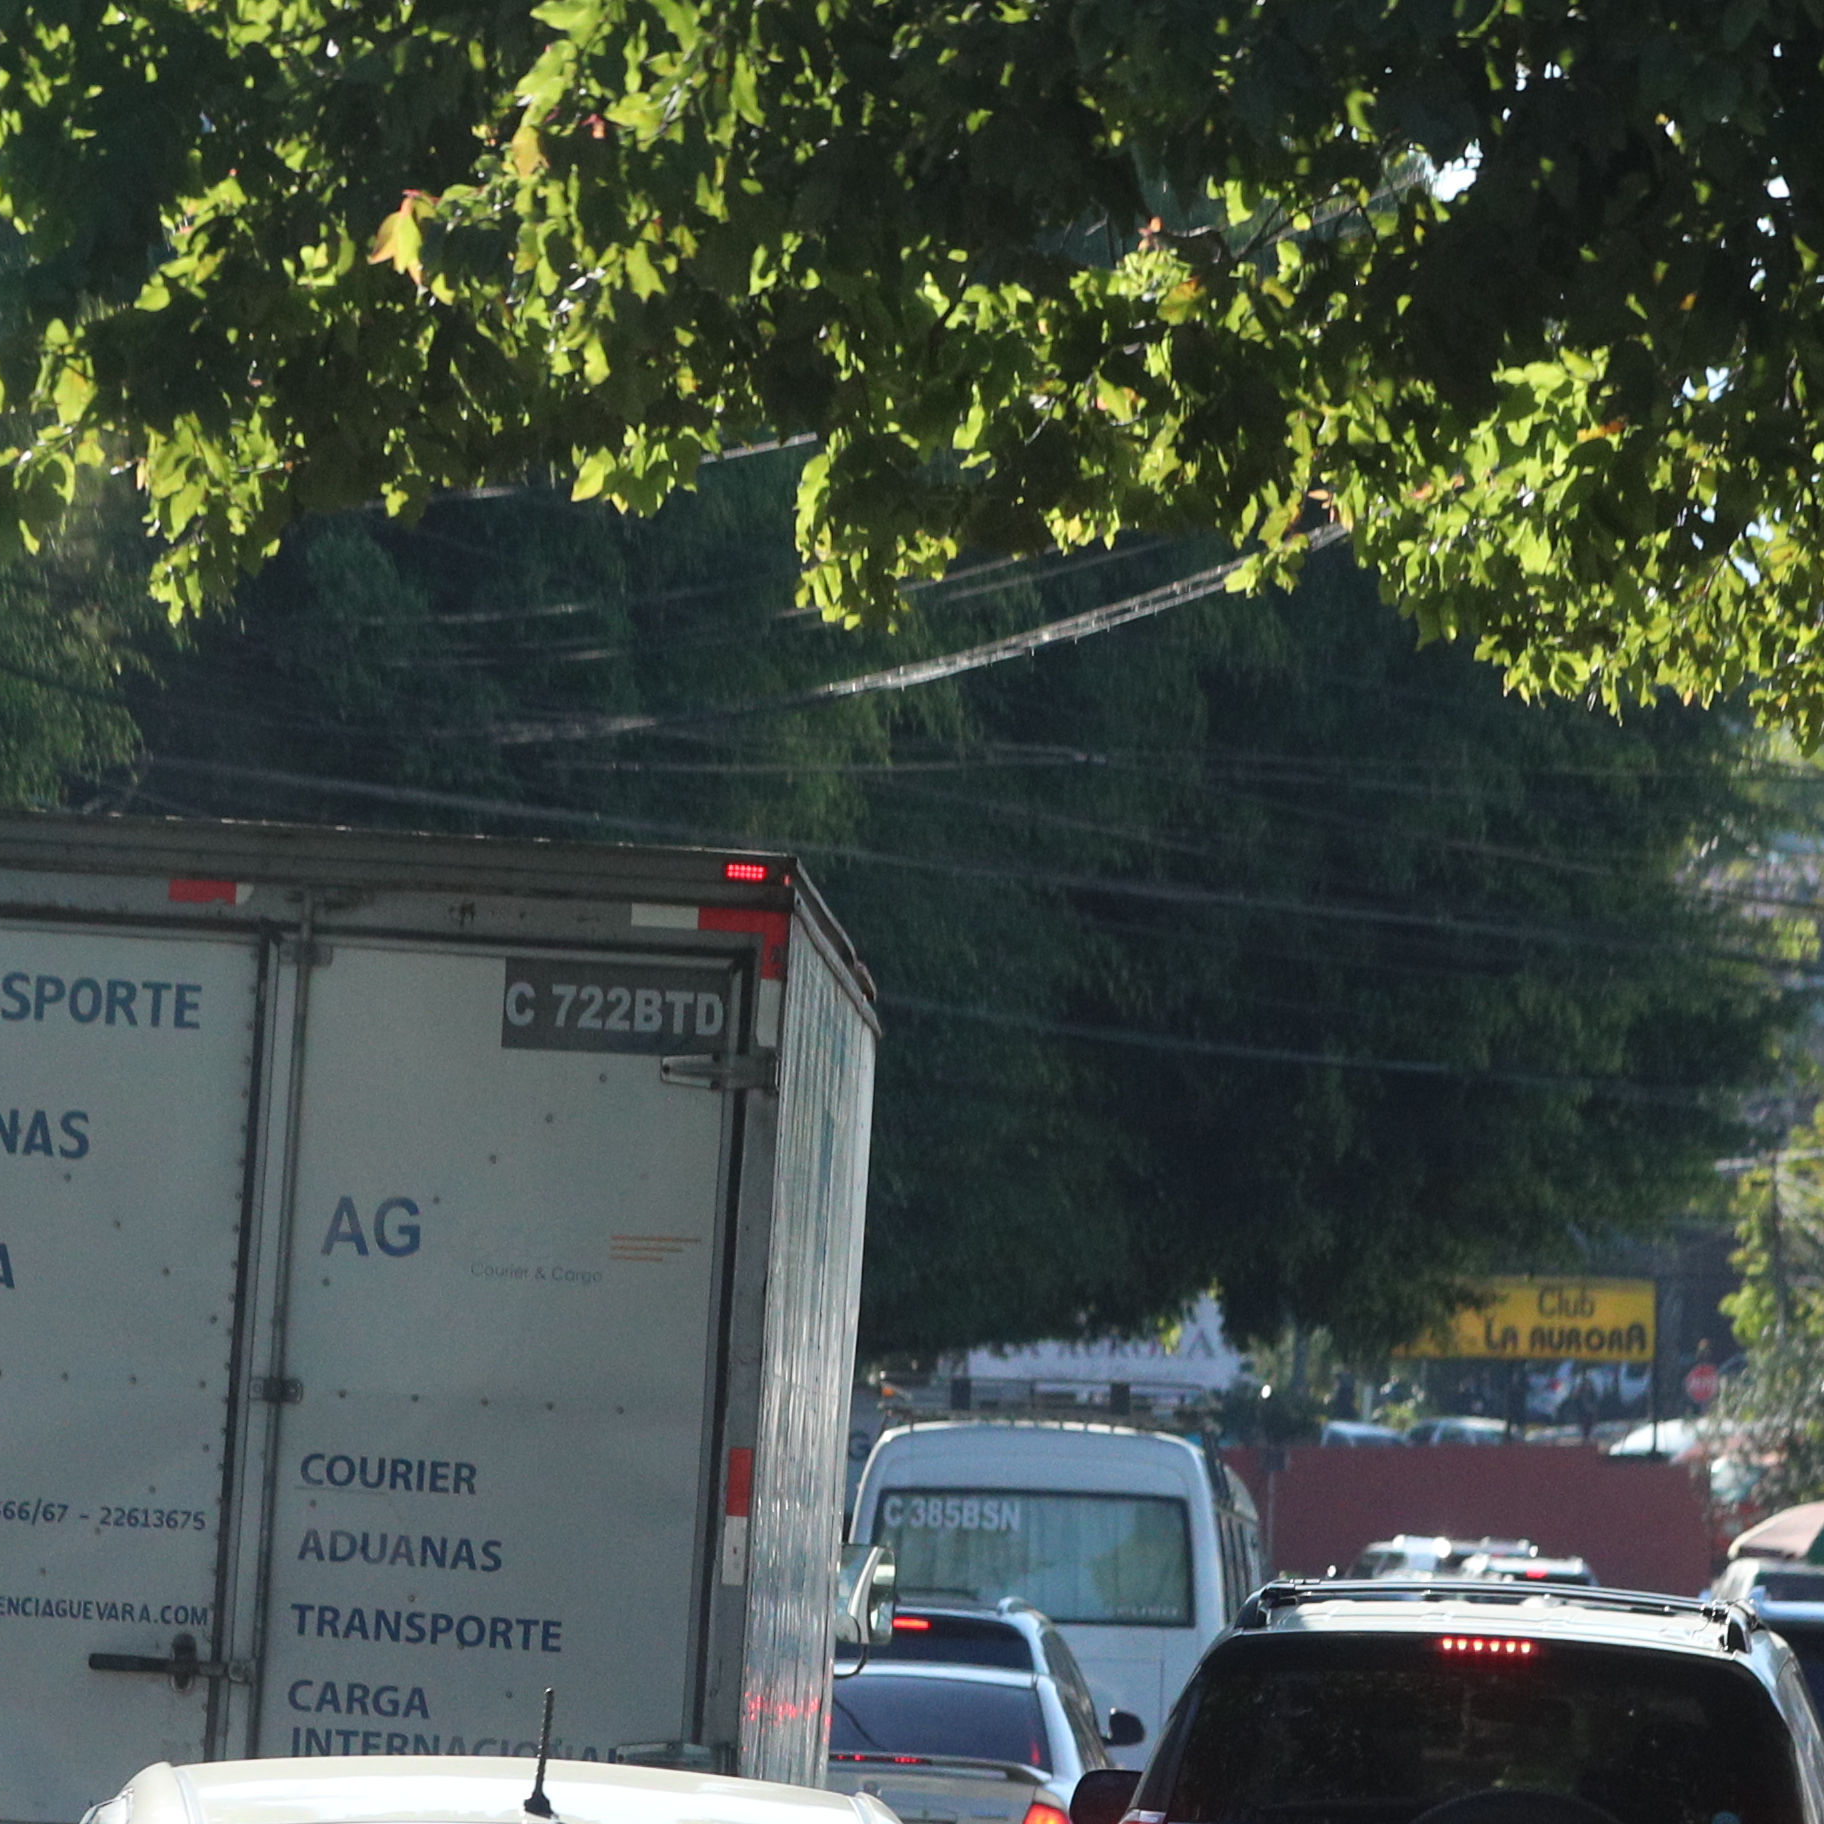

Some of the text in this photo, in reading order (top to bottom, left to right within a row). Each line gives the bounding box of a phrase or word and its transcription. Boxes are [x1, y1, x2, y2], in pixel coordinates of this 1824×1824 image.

[505, 980, 724, 1037] C 722BTD
[320, 1196, 422, 1257] AG
[1537, 1283, 1596, 1319] Club
[300, 1452, 477, 1495] COURIER
[99, 1506, 207, 1531] 22613675
[883, 1496, 1022, 1532] C 385BSN
[296, 1527, 503, 1573] ADUANAS
[291, 1603, 562, 1653] TRANSPORTE
[287, 1679, 430, 1720] CARGA
